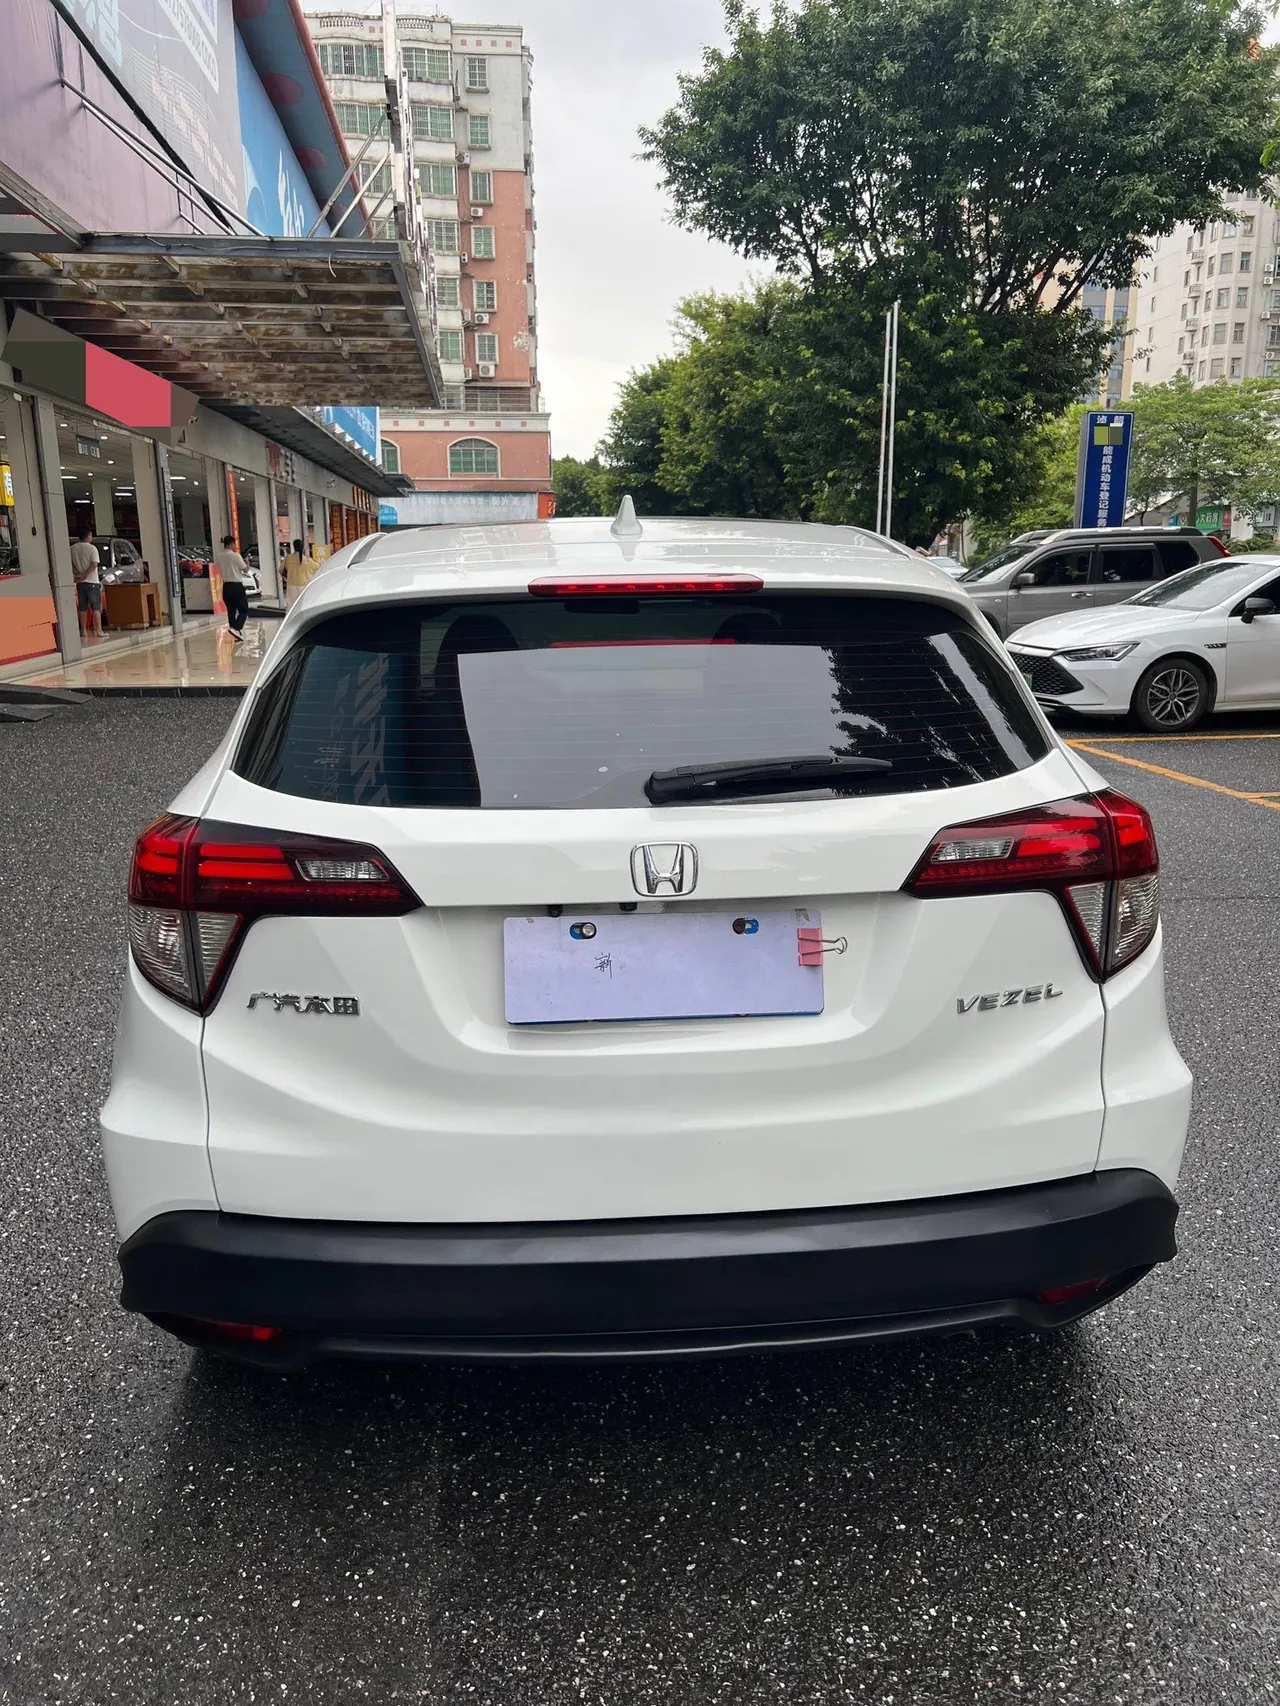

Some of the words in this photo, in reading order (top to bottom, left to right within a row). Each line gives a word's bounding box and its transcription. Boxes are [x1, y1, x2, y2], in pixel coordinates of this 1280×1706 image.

[594, 952, 612, 980] 新
[246, 991, 360, 1016] 广汽本田
[956, 983, 1063, 1015] VEZEL
